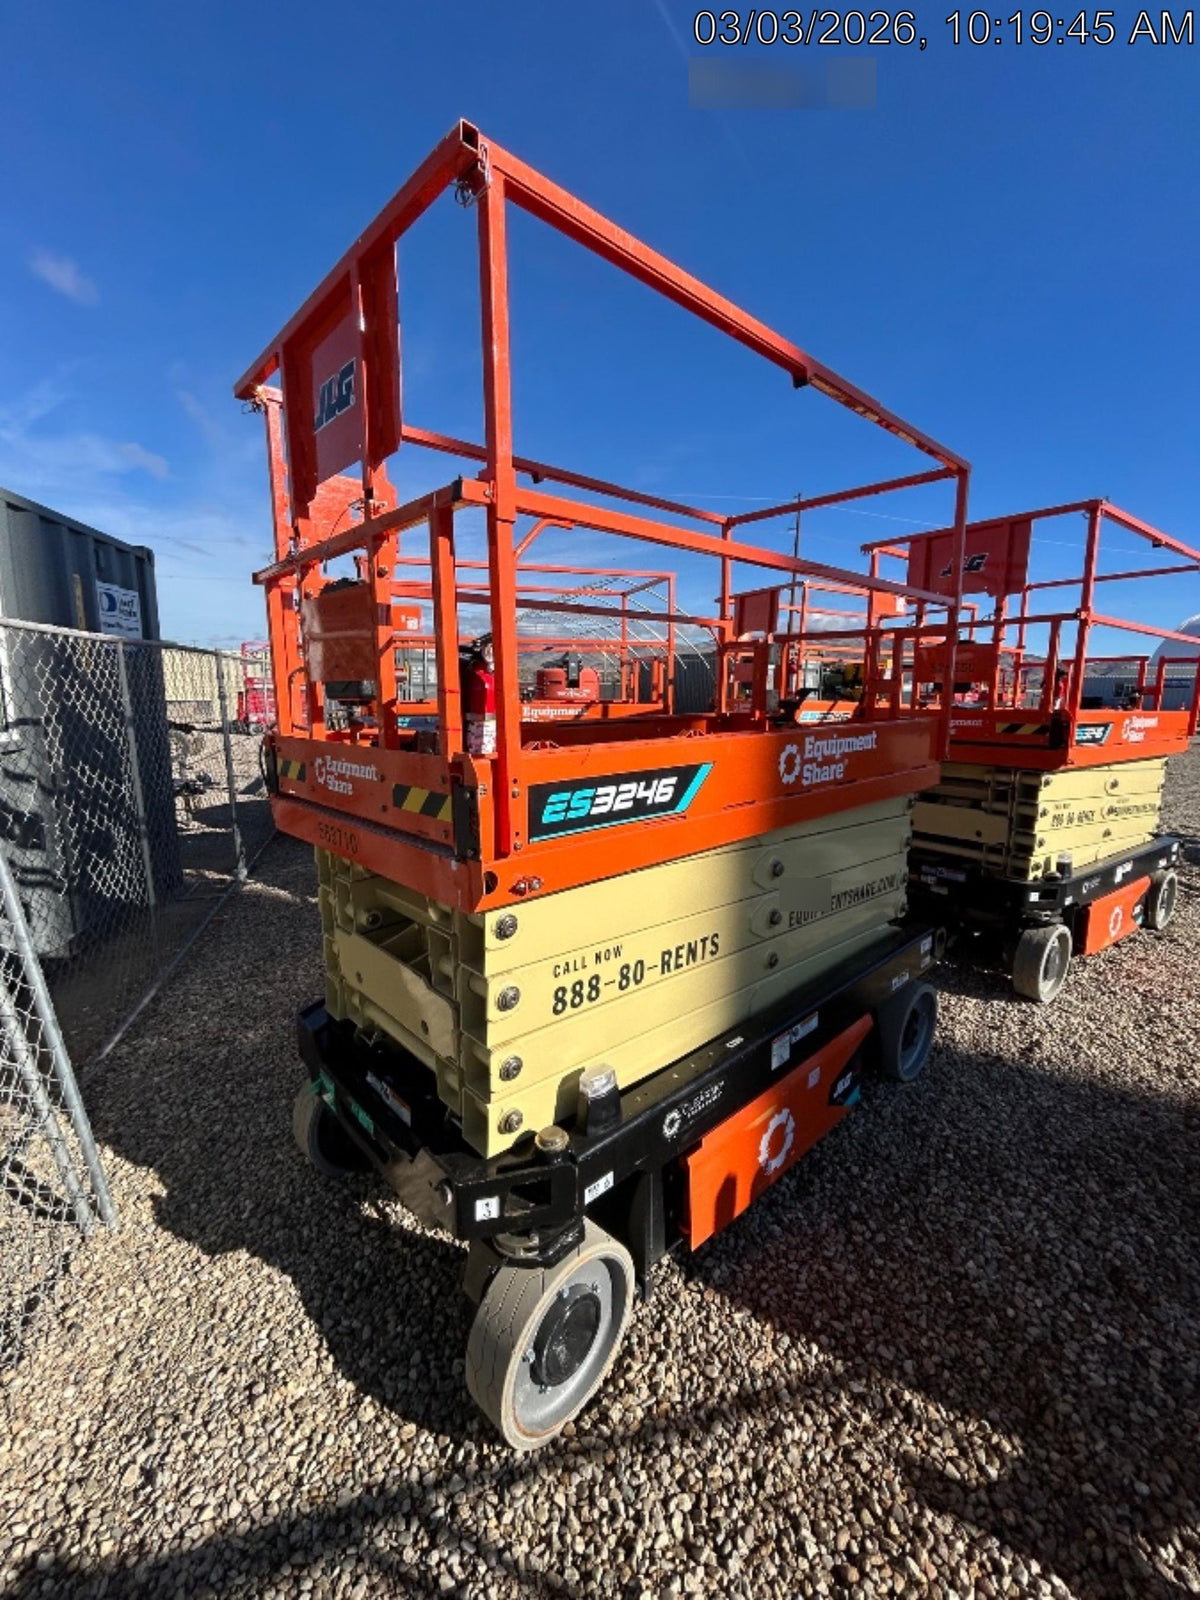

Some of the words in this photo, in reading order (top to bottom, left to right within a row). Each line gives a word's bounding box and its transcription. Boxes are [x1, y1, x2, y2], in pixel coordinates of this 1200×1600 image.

[314, 357, 357, 435] JLG
[803, 730, 878, 761] Equipment
[325, 755, 378, 781] Equipment
[801, 762, 844, 787] Share
[541, 776, 679, 824] ES3246
[552, 933, 720, 1015] 888-80-RENTS
[553, 956, 587, 978] CALL
[595, 944, 623, 965] NOW
